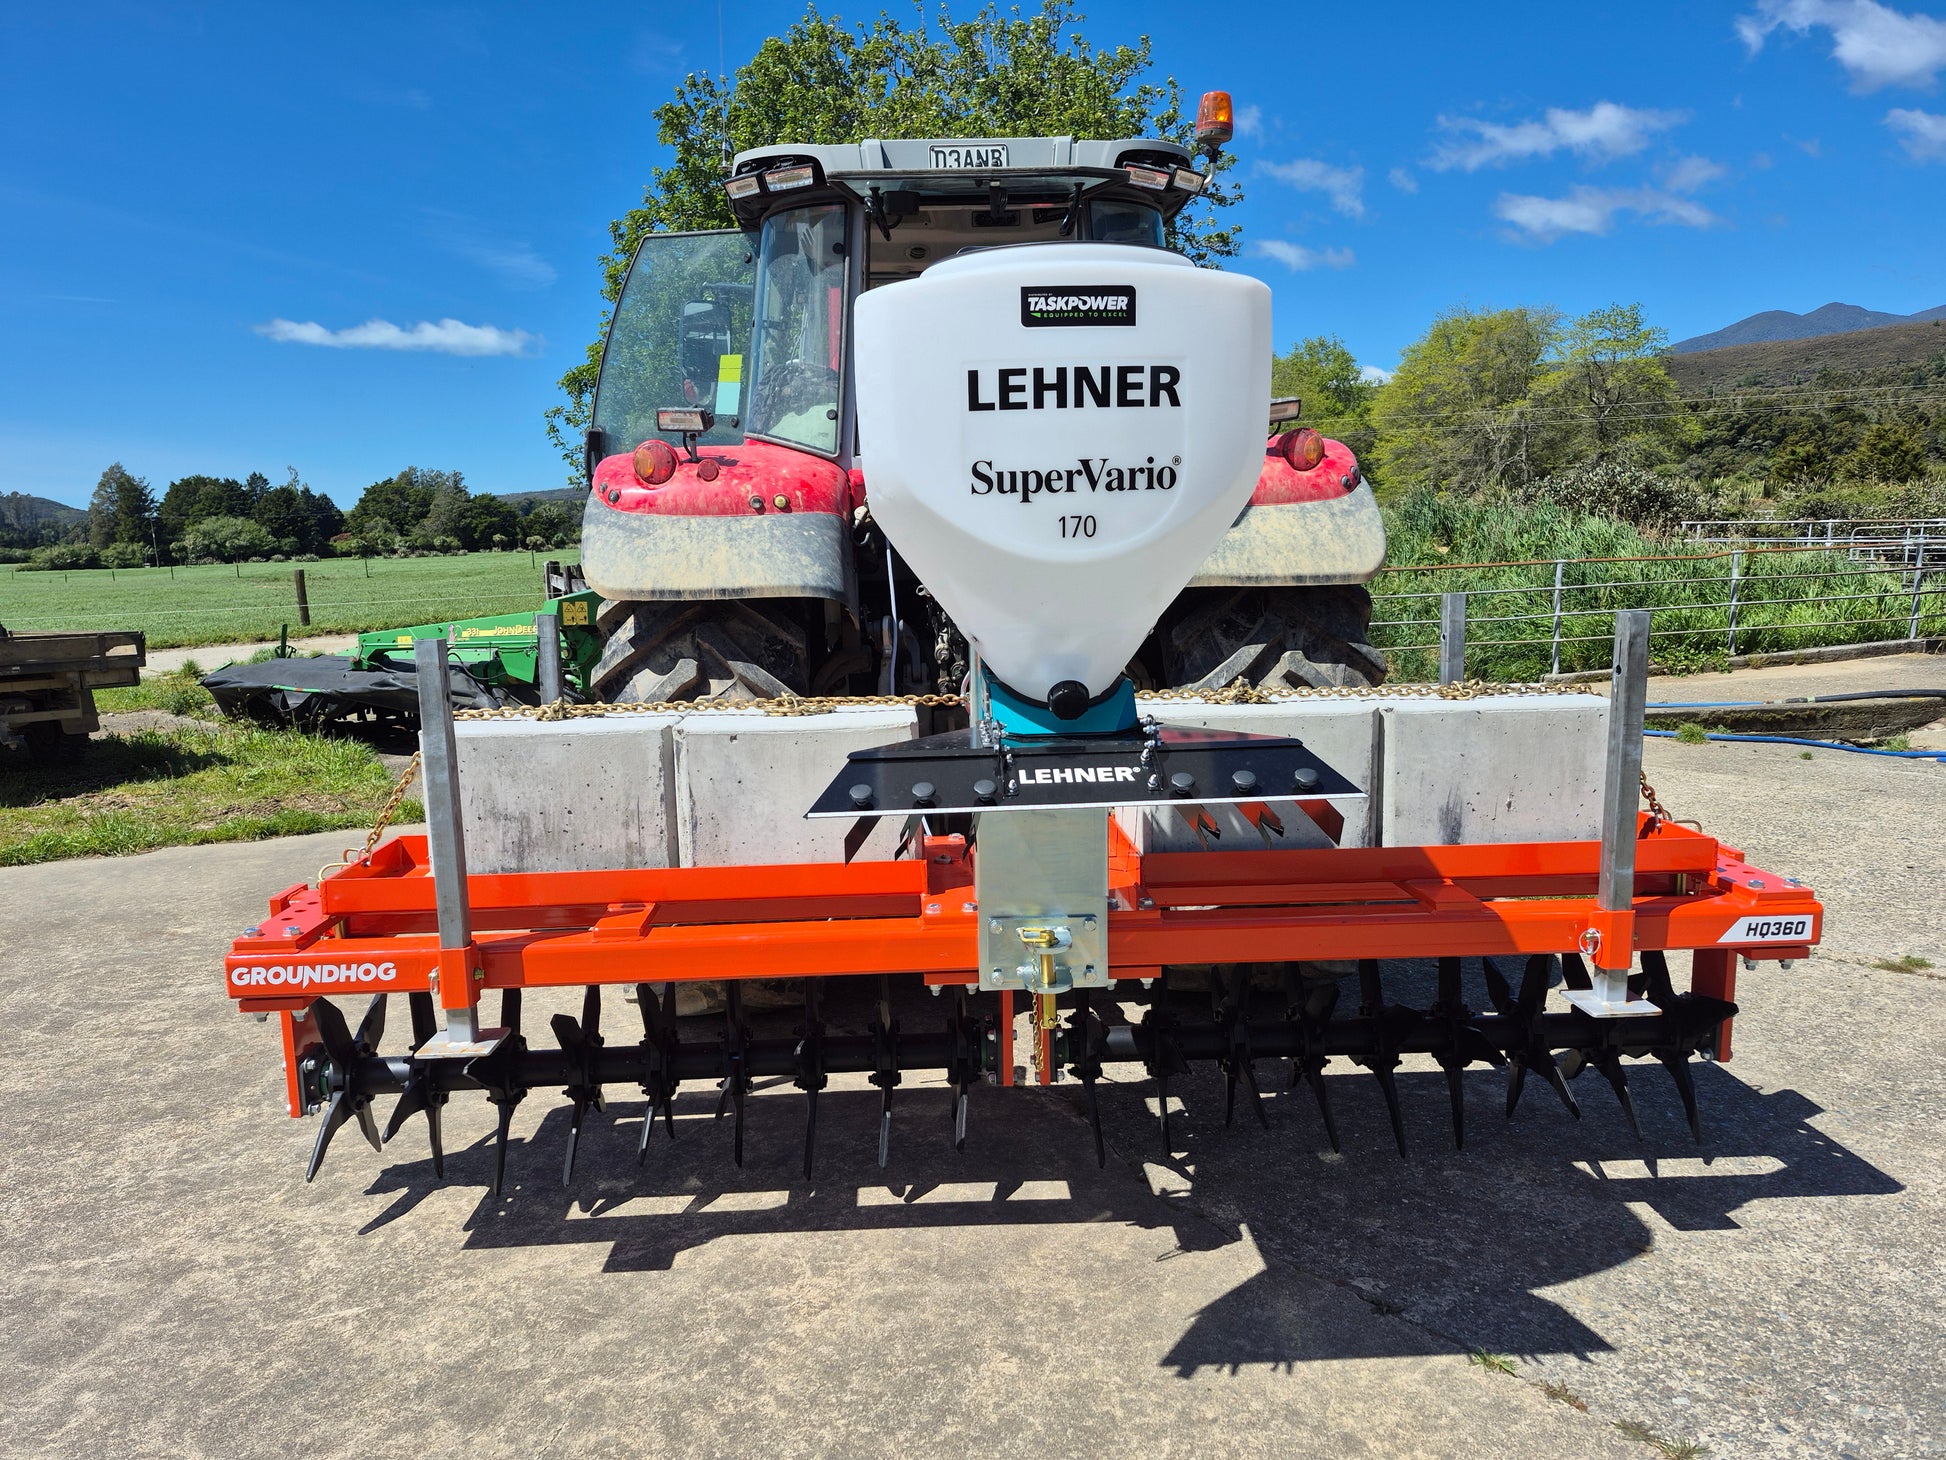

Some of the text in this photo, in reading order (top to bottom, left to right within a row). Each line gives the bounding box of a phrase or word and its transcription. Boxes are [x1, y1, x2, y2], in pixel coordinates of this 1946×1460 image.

[1028, 296, 1128, 311] TASKPOWER
[967, 365, 1181, 411] LEHNER
[1058, 515, 1097, 538] 170
[494, 625, 515, 635] JOHN
[1746, 921, 1806, 938] HQ360
[231, 962, 397, 989] GROUNDHOG
